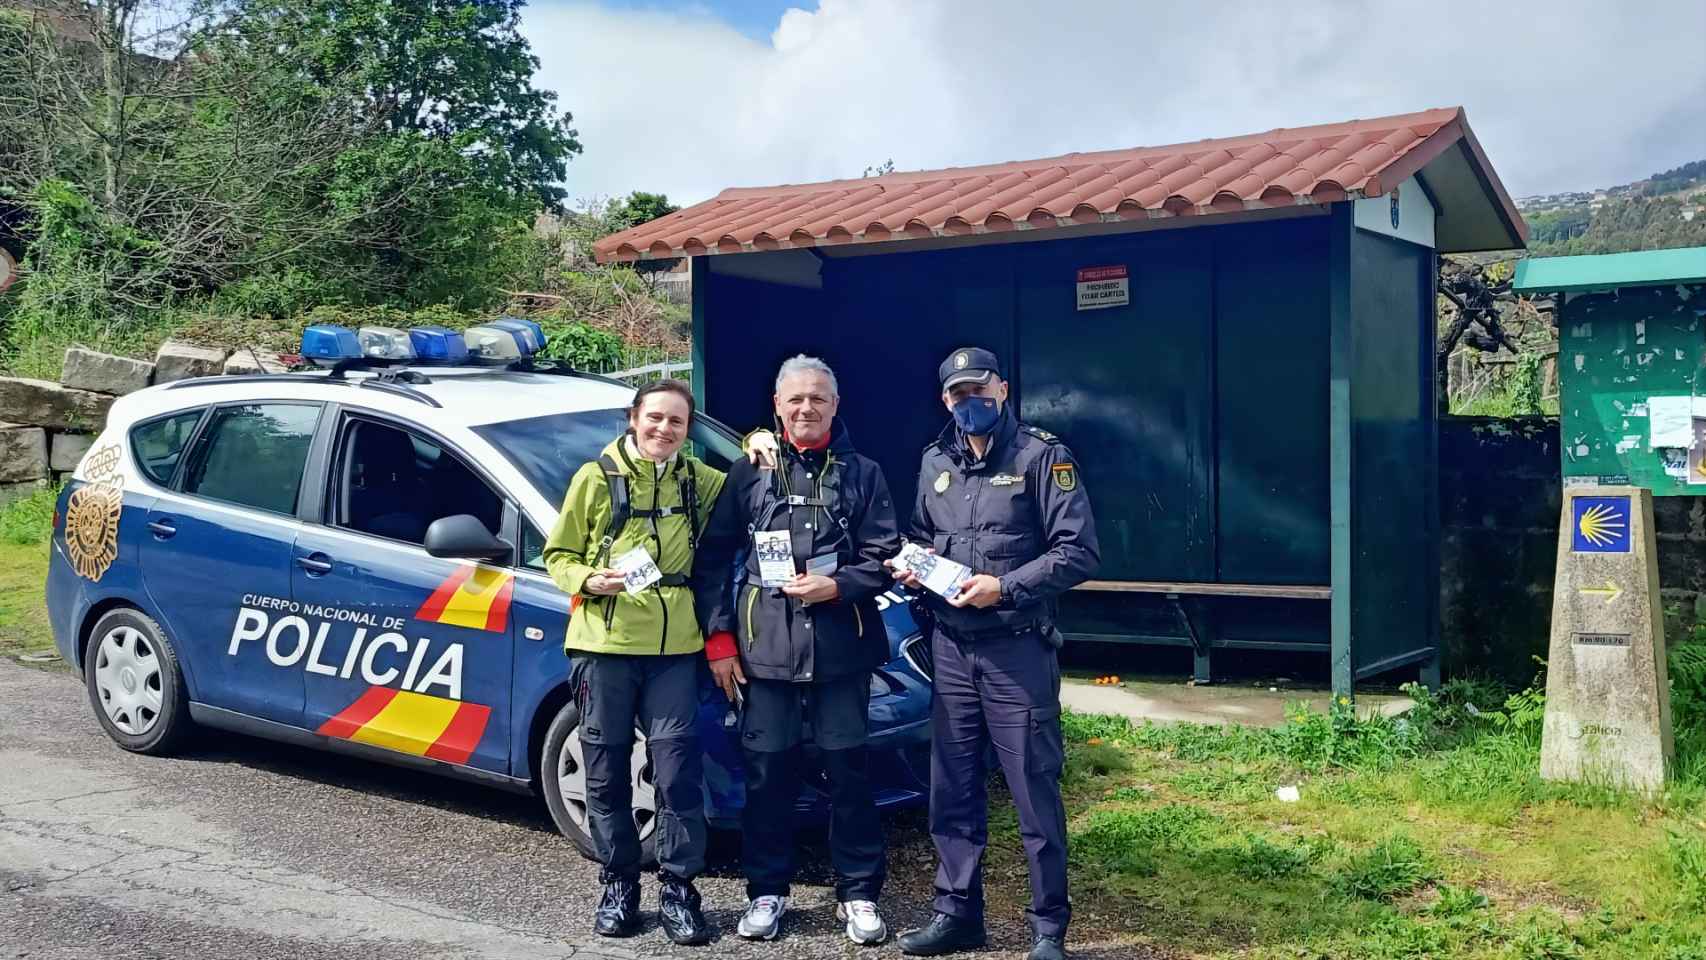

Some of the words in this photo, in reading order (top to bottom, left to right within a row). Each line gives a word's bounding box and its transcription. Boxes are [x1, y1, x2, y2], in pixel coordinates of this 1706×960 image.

[241, 594, 300, 613] CUERPO
[303, 603, 378, 626] NACIONAL
[382, 616, 405, 630] DE
[227, 607, 464, 700] POLICIA
